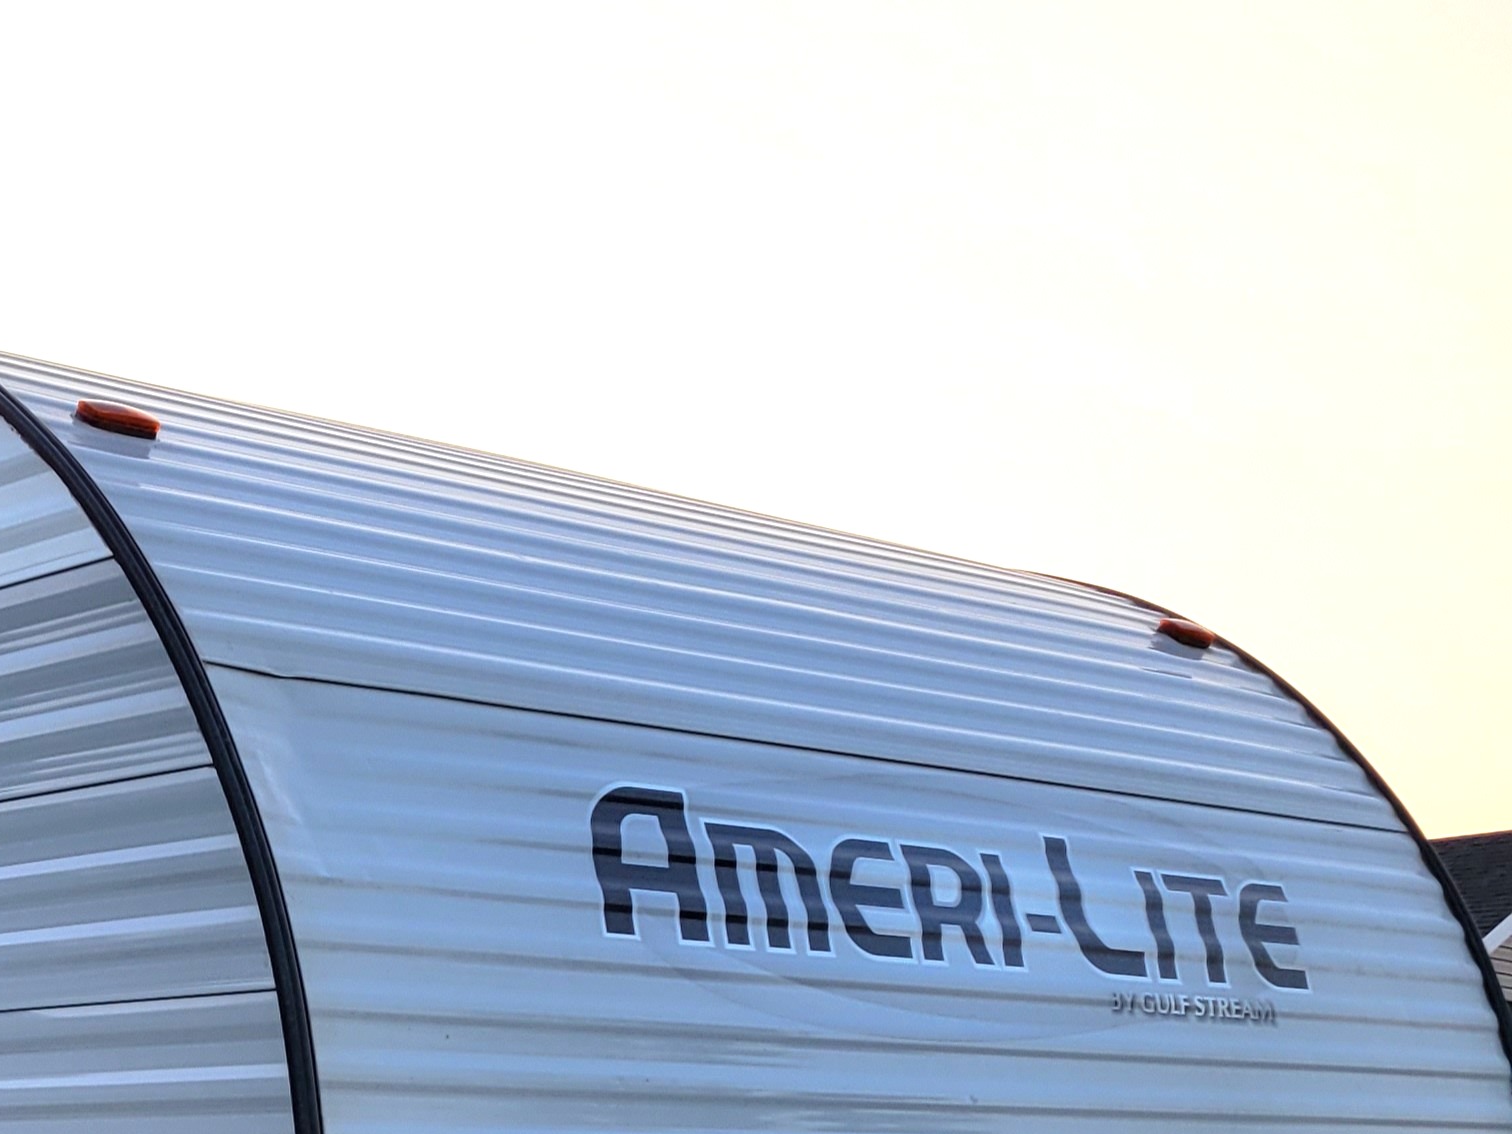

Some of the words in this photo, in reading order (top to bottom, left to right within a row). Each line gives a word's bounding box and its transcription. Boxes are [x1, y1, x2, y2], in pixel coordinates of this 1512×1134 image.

[590, 785, 1311, 990] AMERI-LITE
[1141, 991, 1190, 1016] GULF
[1195, 994, 1275, 1023] STREAM
